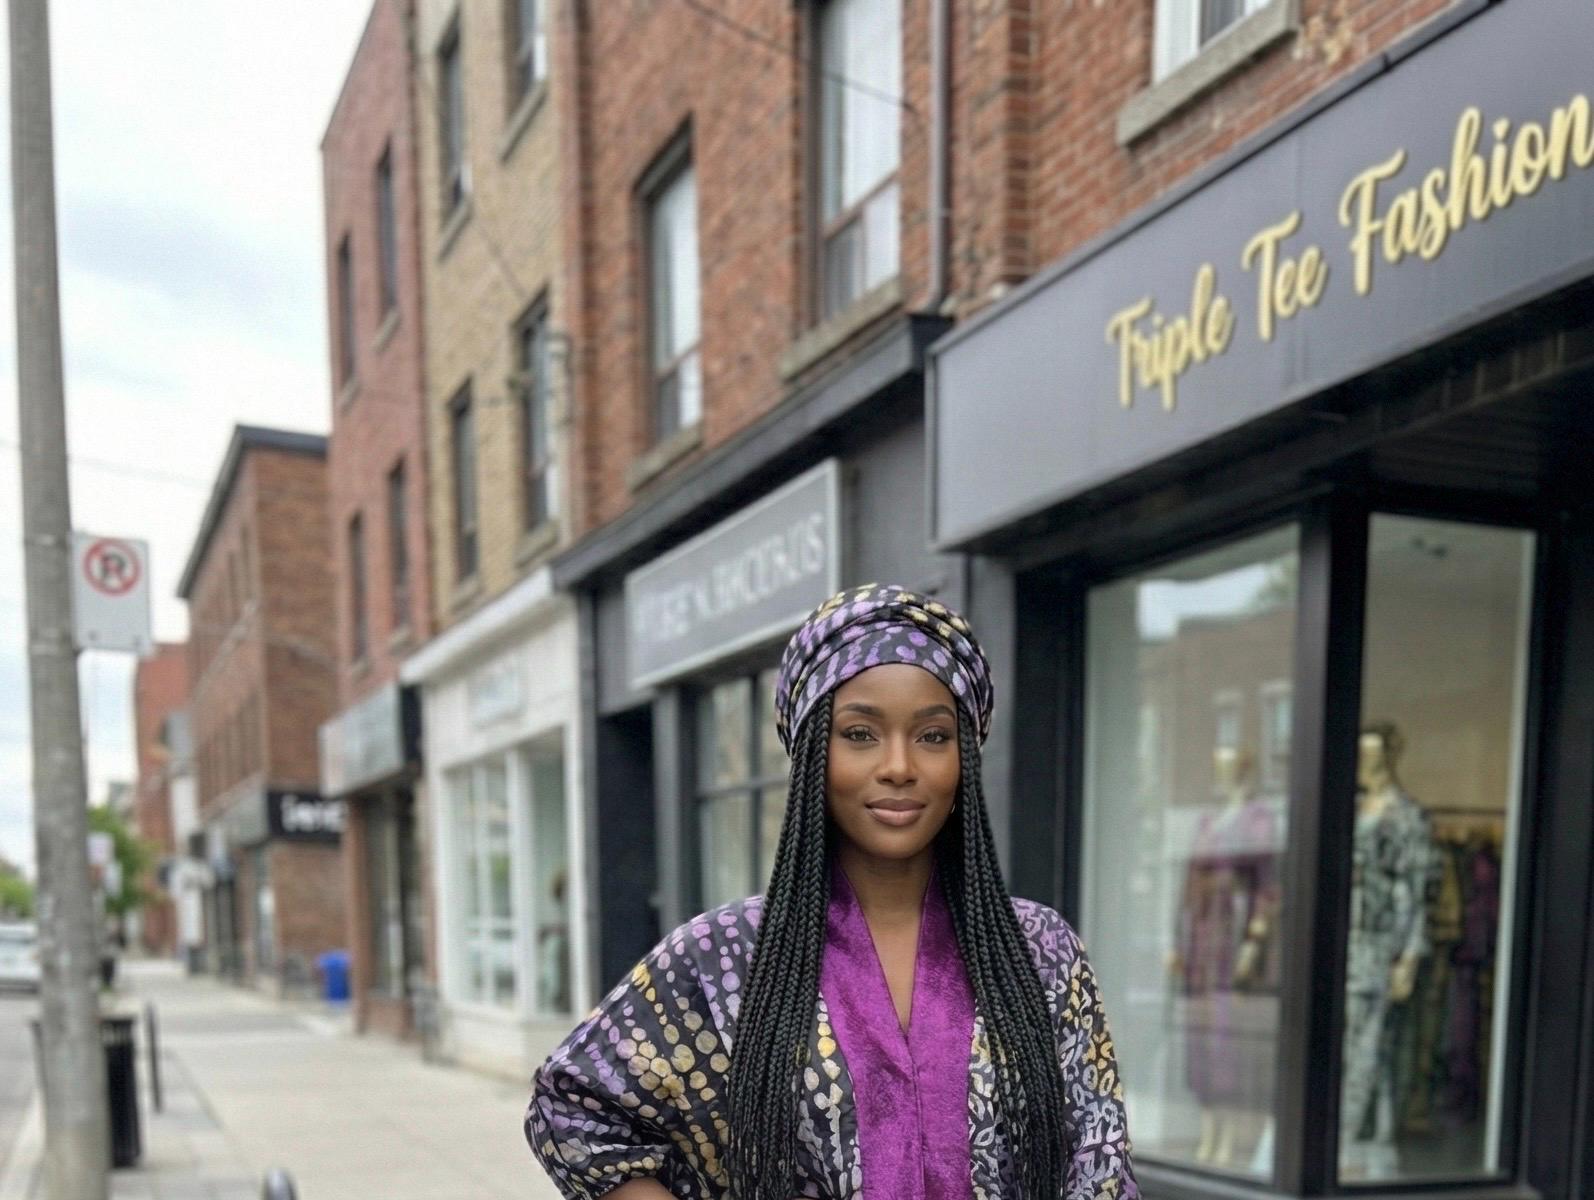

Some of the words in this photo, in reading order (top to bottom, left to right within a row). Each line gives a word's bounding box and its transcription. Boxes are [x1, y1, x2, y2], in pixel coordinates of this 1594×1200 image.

[1106, 264, 1234, 410] Triple
[1241, 211, 1329, 342] Tee
[1338, 94, 1594, 296] Fashion
